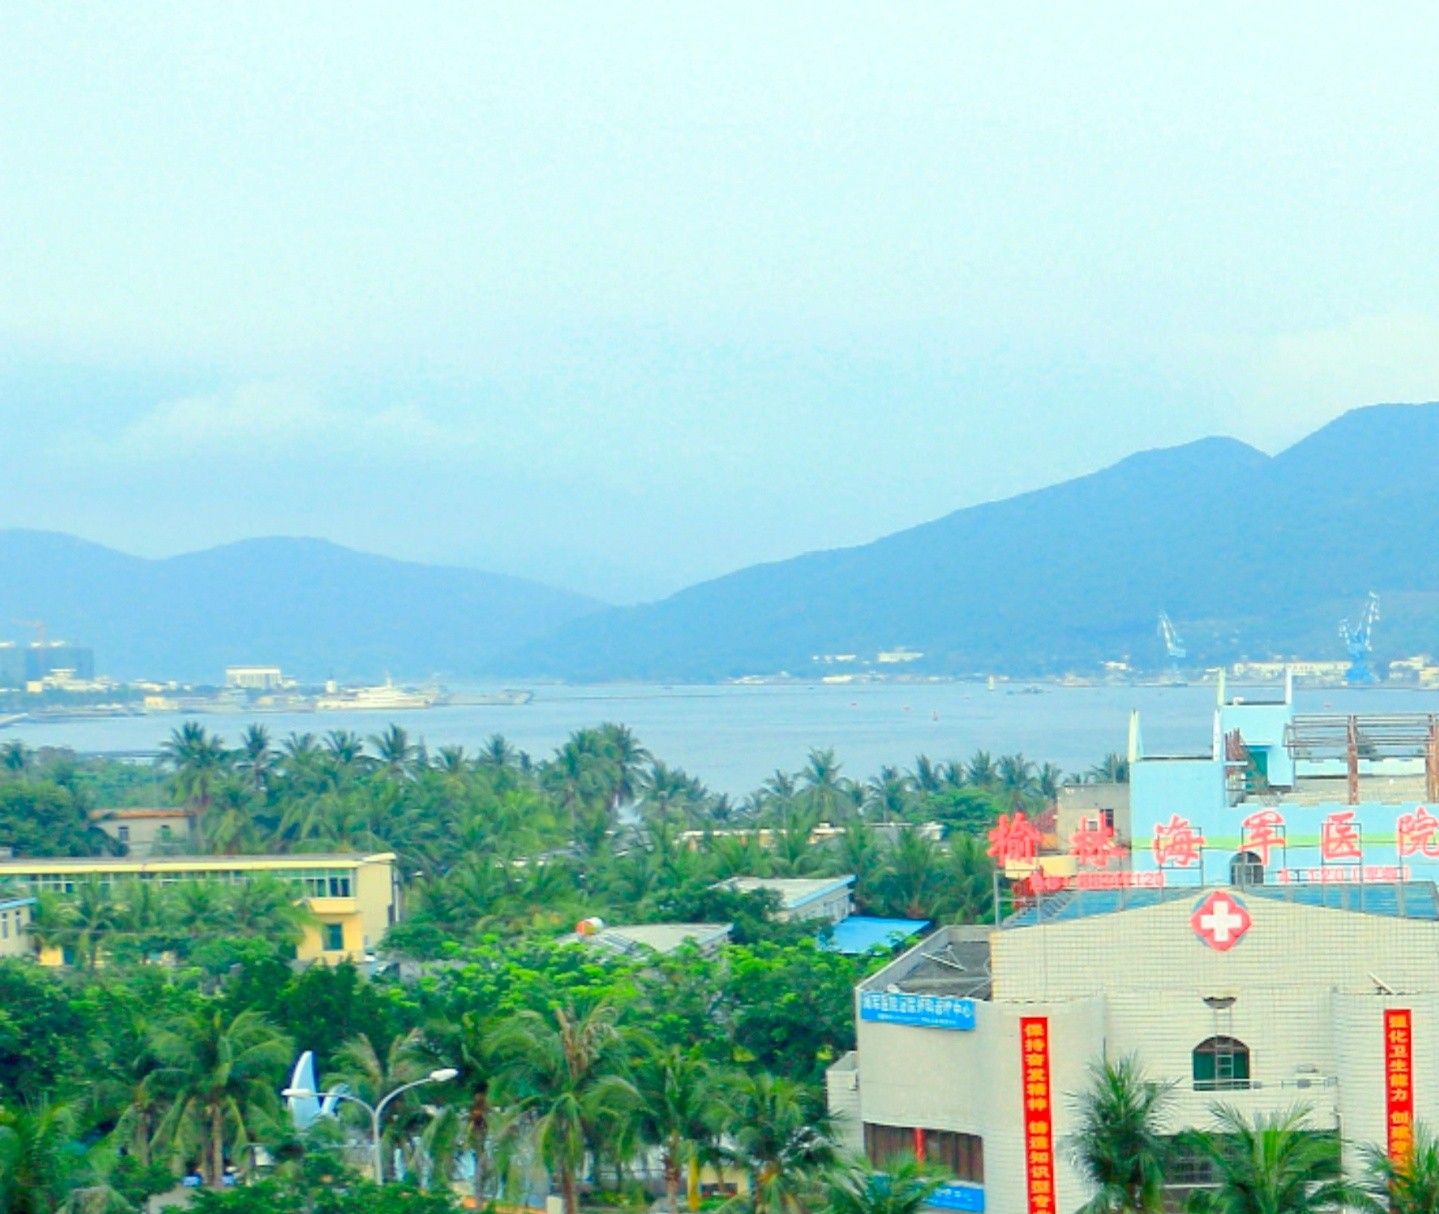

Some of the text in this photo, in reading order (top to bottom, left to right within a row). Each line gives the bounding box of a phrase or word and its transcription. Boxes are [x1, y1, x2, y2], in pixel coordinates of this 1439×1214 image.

[1388, 1014, 1409, 1102] 强化卫生能力
